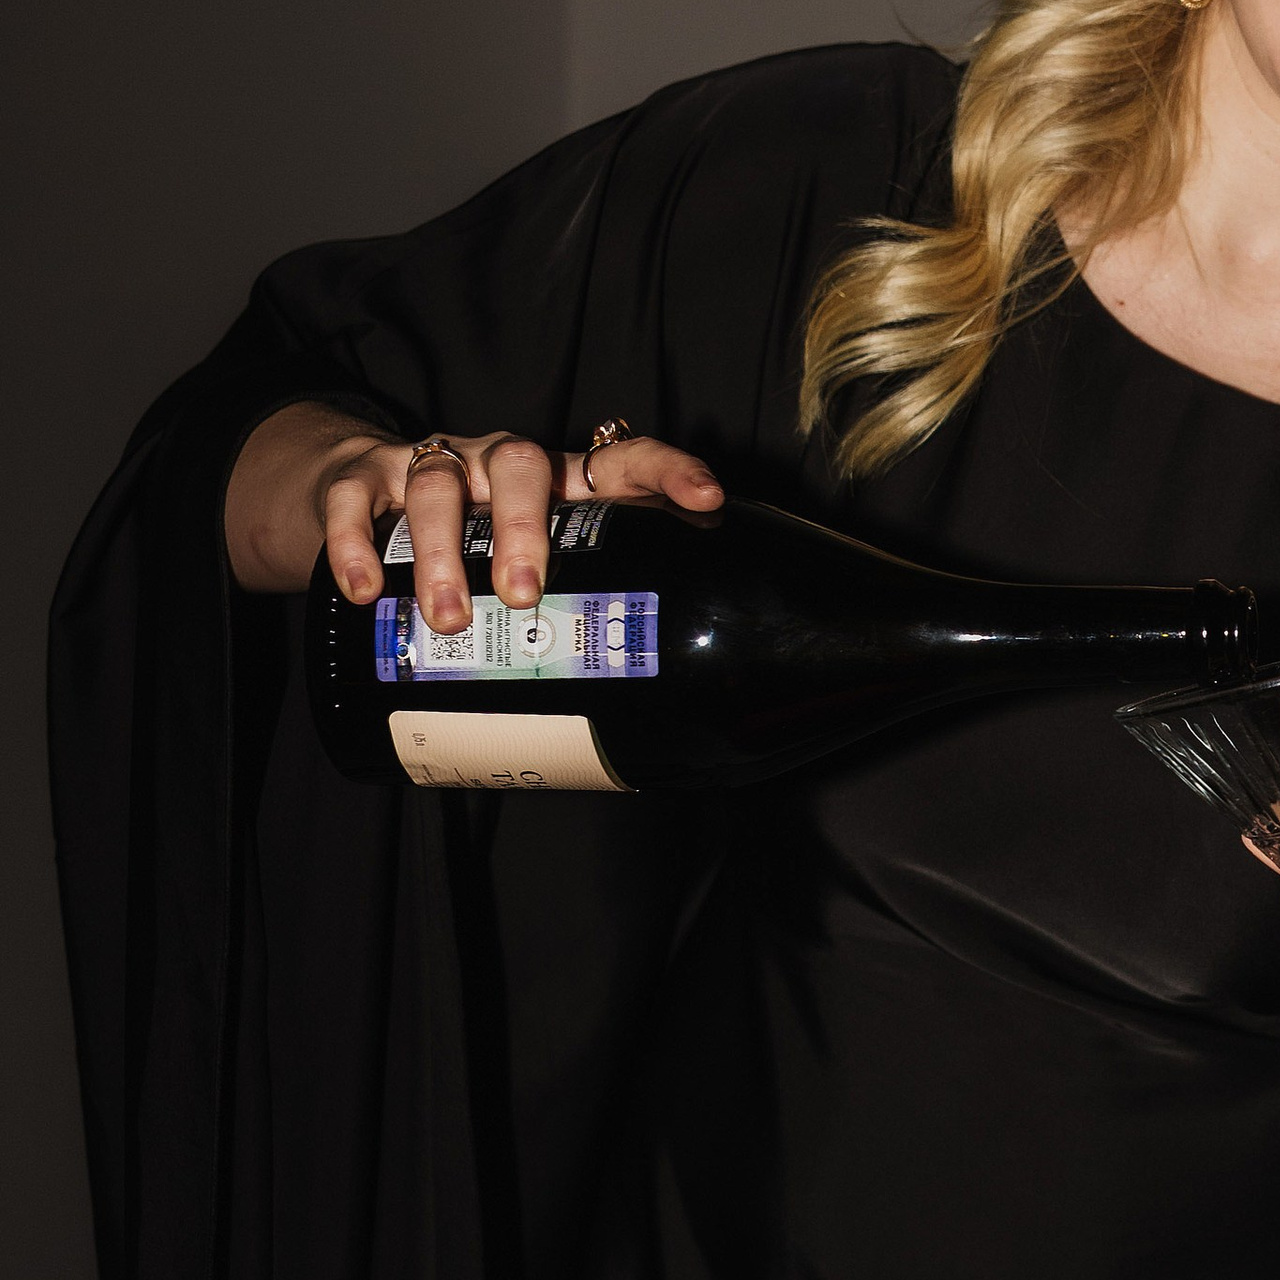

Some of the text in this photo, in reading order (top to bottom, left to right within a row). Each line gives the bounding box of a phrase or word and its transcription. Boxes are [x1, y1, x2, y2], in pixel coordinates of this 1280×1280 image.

[574, 618, 582, 652] МАРКА
[583, 600, 591, 670] СПЕЦИАЛЬНАЯ
[591, 600, 600, 670] ФЕДЕРАЛЬНАЯ
[629, 602, 638, 667] ФЕДЕРАЦИЯ
[638, 601, 646, 667] РОССИЙСКАЯ
